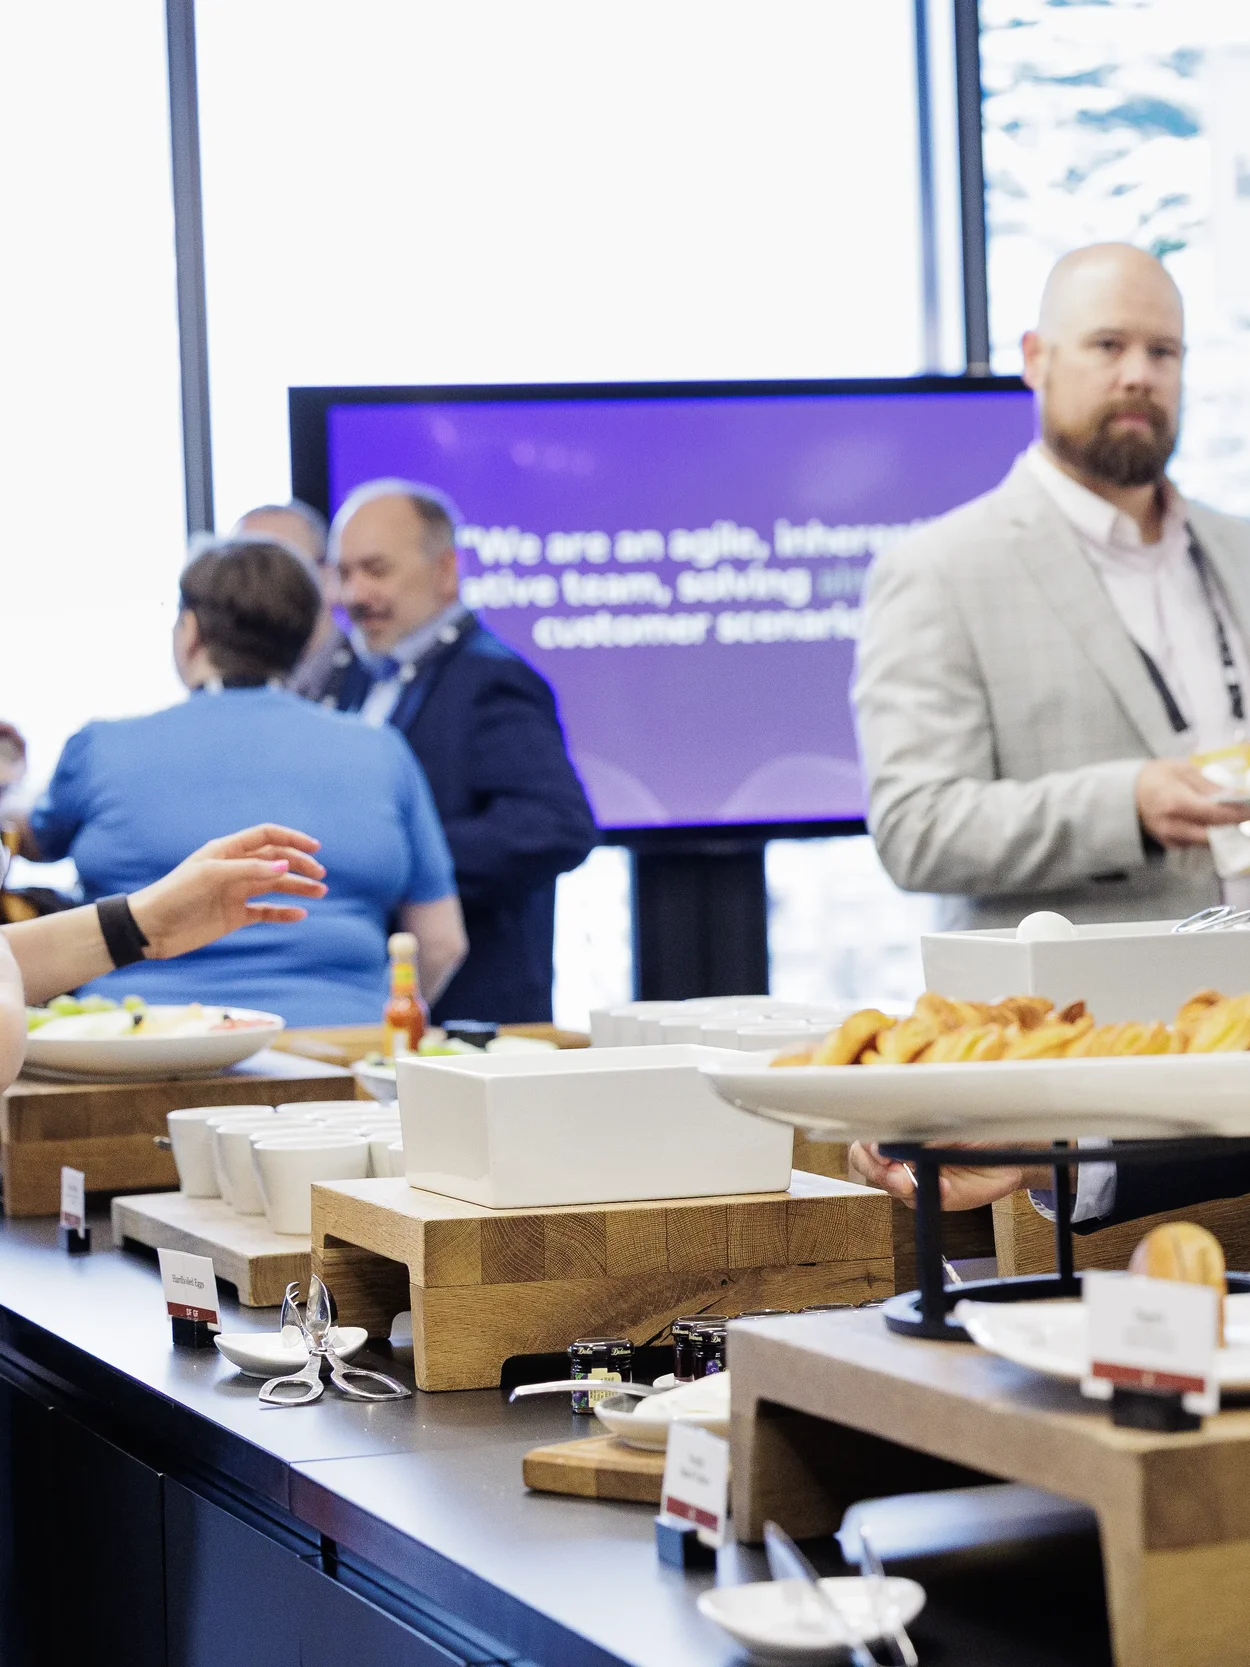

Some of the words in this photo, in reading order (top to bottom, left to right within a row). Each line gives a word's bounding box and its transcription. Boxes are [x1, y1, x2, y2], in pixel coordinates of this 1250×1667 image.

[546, 531, 611, 565] are
[614, 530, 664, 563] an
[562, 571, 672, 608] team,
[677, 566, 812, 608] solving
[532, 612, 712, 649] customer
